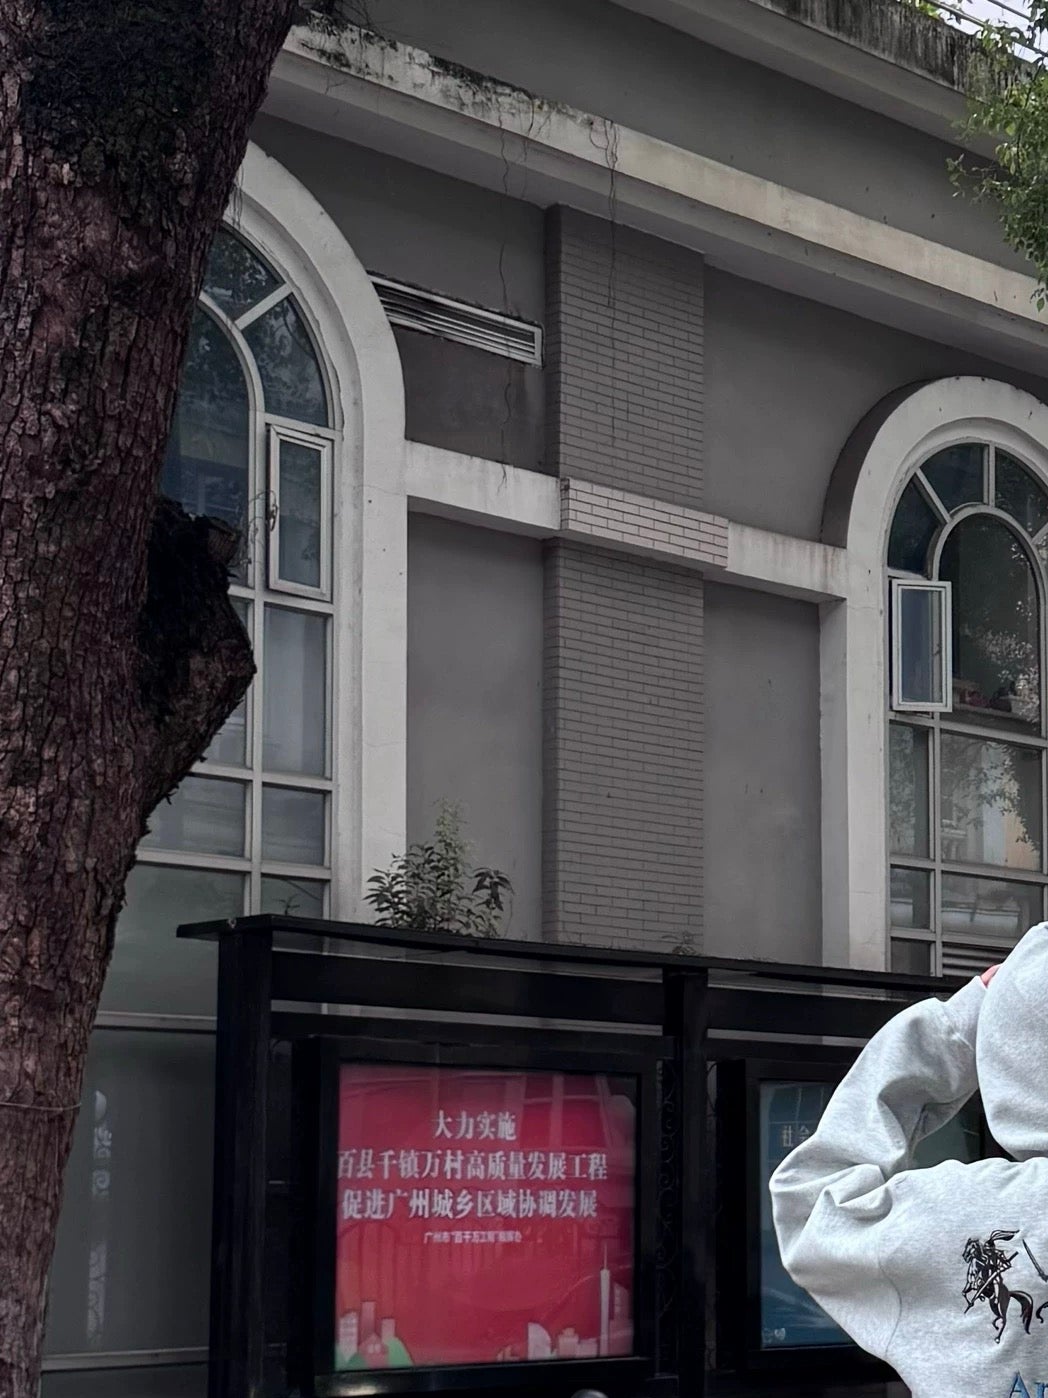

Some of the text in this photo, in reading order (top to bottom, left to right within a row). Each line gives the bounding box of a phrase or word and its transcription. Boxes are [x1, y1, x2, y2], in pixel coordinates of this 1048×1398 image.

[433, 1109, 518, 1141] 大力实施
[338, 1148, 608, 1181] 百县千镇万村高质量发展工程
[342, 1188, 598, 1220] 促进广州城乡区域协调发展
